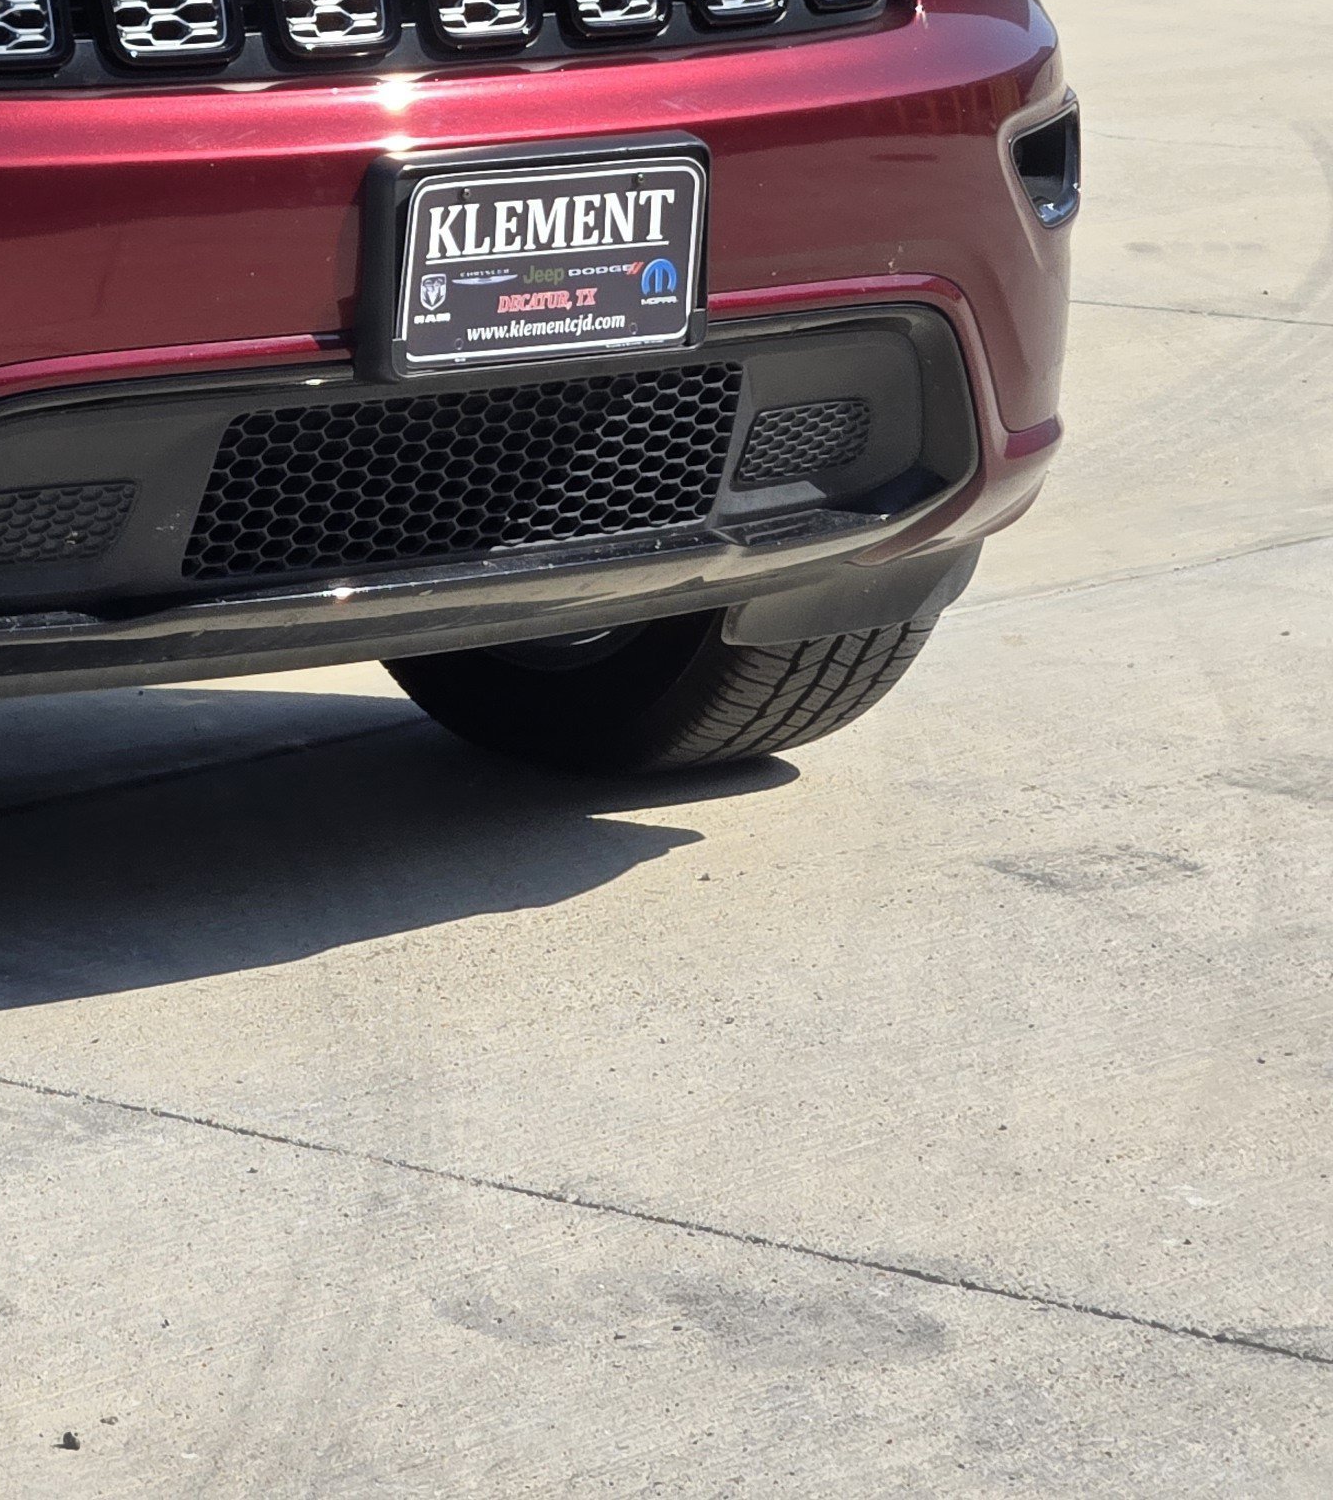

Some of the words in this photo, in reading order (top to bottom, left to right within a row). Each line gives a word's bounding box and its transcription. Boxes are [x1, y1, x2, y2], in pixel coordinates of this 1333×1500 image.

[425, 188, 676, 260] KLEMENT
[522, 265, 565, 286] Jeep
[568, 263, 634, 277] DODGE
[496, 289, 573, 314] DECATUR,
[575, 287, 599, 307] TX
[413, 311, 452, 324] RAM
[466, 313, 626, 343] www.klementcjd.com
